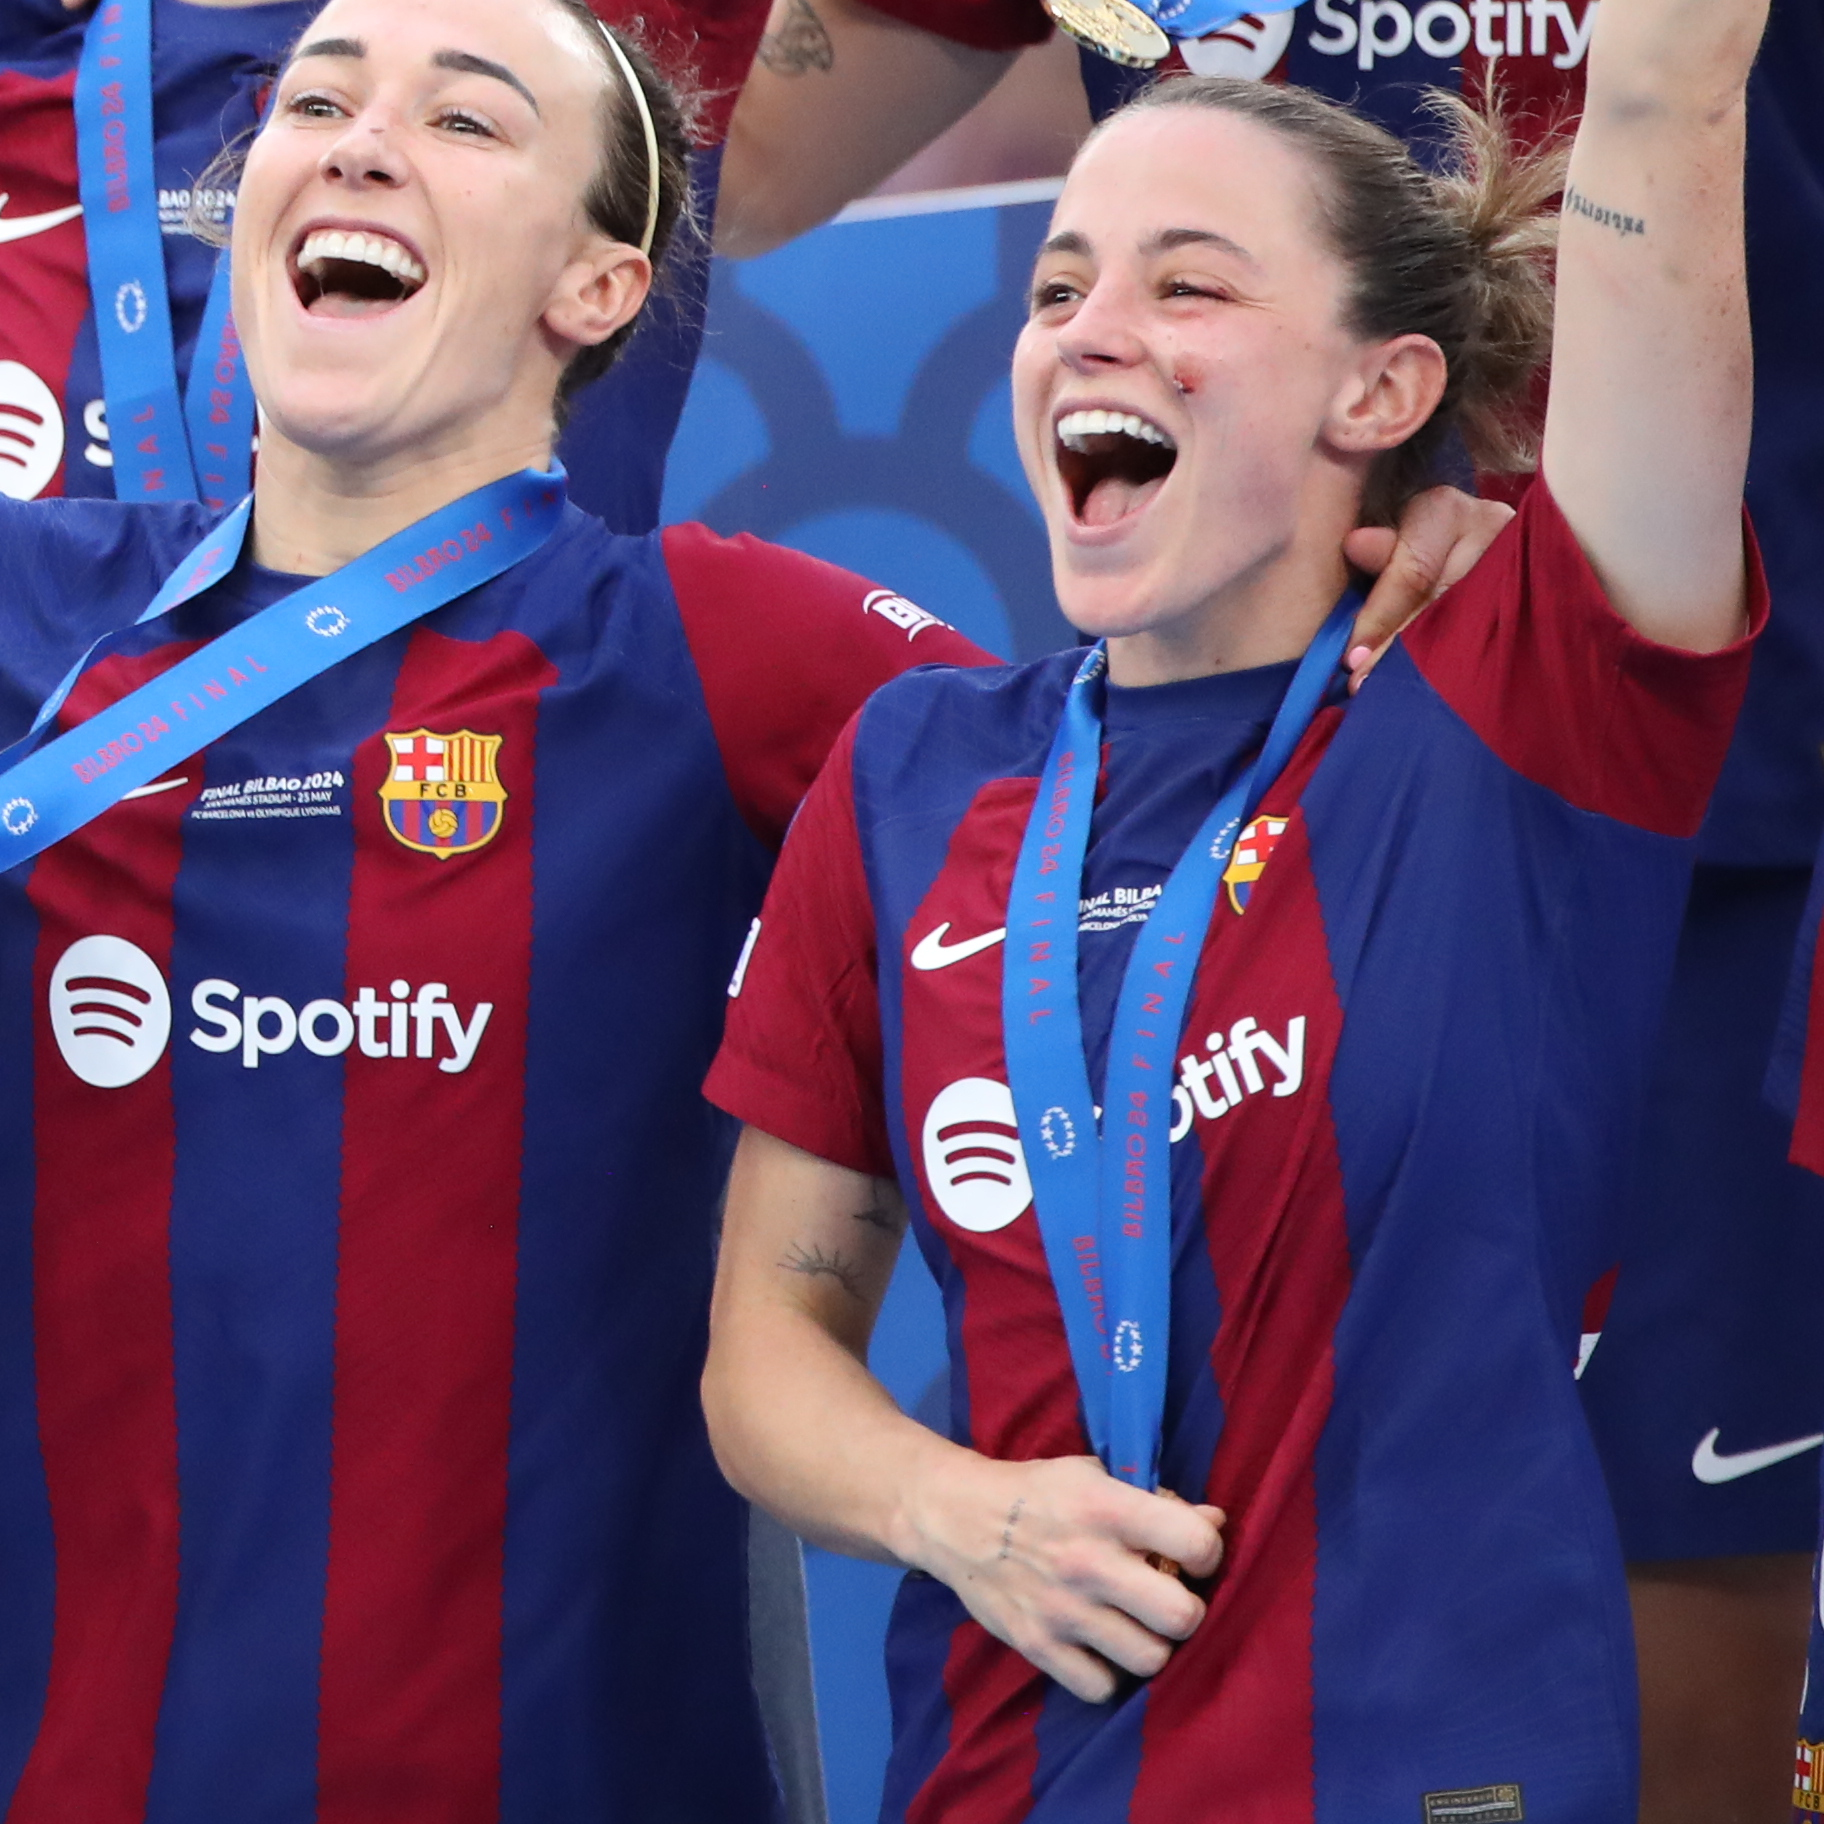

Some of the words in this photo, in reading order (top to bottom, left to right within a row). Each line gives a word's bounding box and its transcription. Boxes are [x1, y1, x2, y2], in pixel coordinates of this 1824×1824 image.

[385, 539, 464, 593] BILBAO
[459, 522, 493, 553] 24
[71, 731, 144, 785] BILBAO
[137, 715, 171, 743] 24
[170, 655, 269, 722] FINAL
[201, 783, 240, 801] FINAL
[243, 776, 301, 794] BILBAO
[301, 770, 345, 790] 2024
[310, 790, 333, 803] MAY
[420, 783, 467, 800] FCB
[1045, 750, 1075, 838] BILBAO
[1038, 842, 1063, 875] 24
[1079, 890, 1111, 913] INAL
[1114, 884, 1163, 905] BILBA
[1028, 890, 1056, 1025] FINAL
[189, 978, 494, 1074] Spotify
[1131, 931, 1186, 1070] FINAL
[1126, 1090, 1150, 1127] 24
[1122, 1133, 1147, 1239] BILBAO
